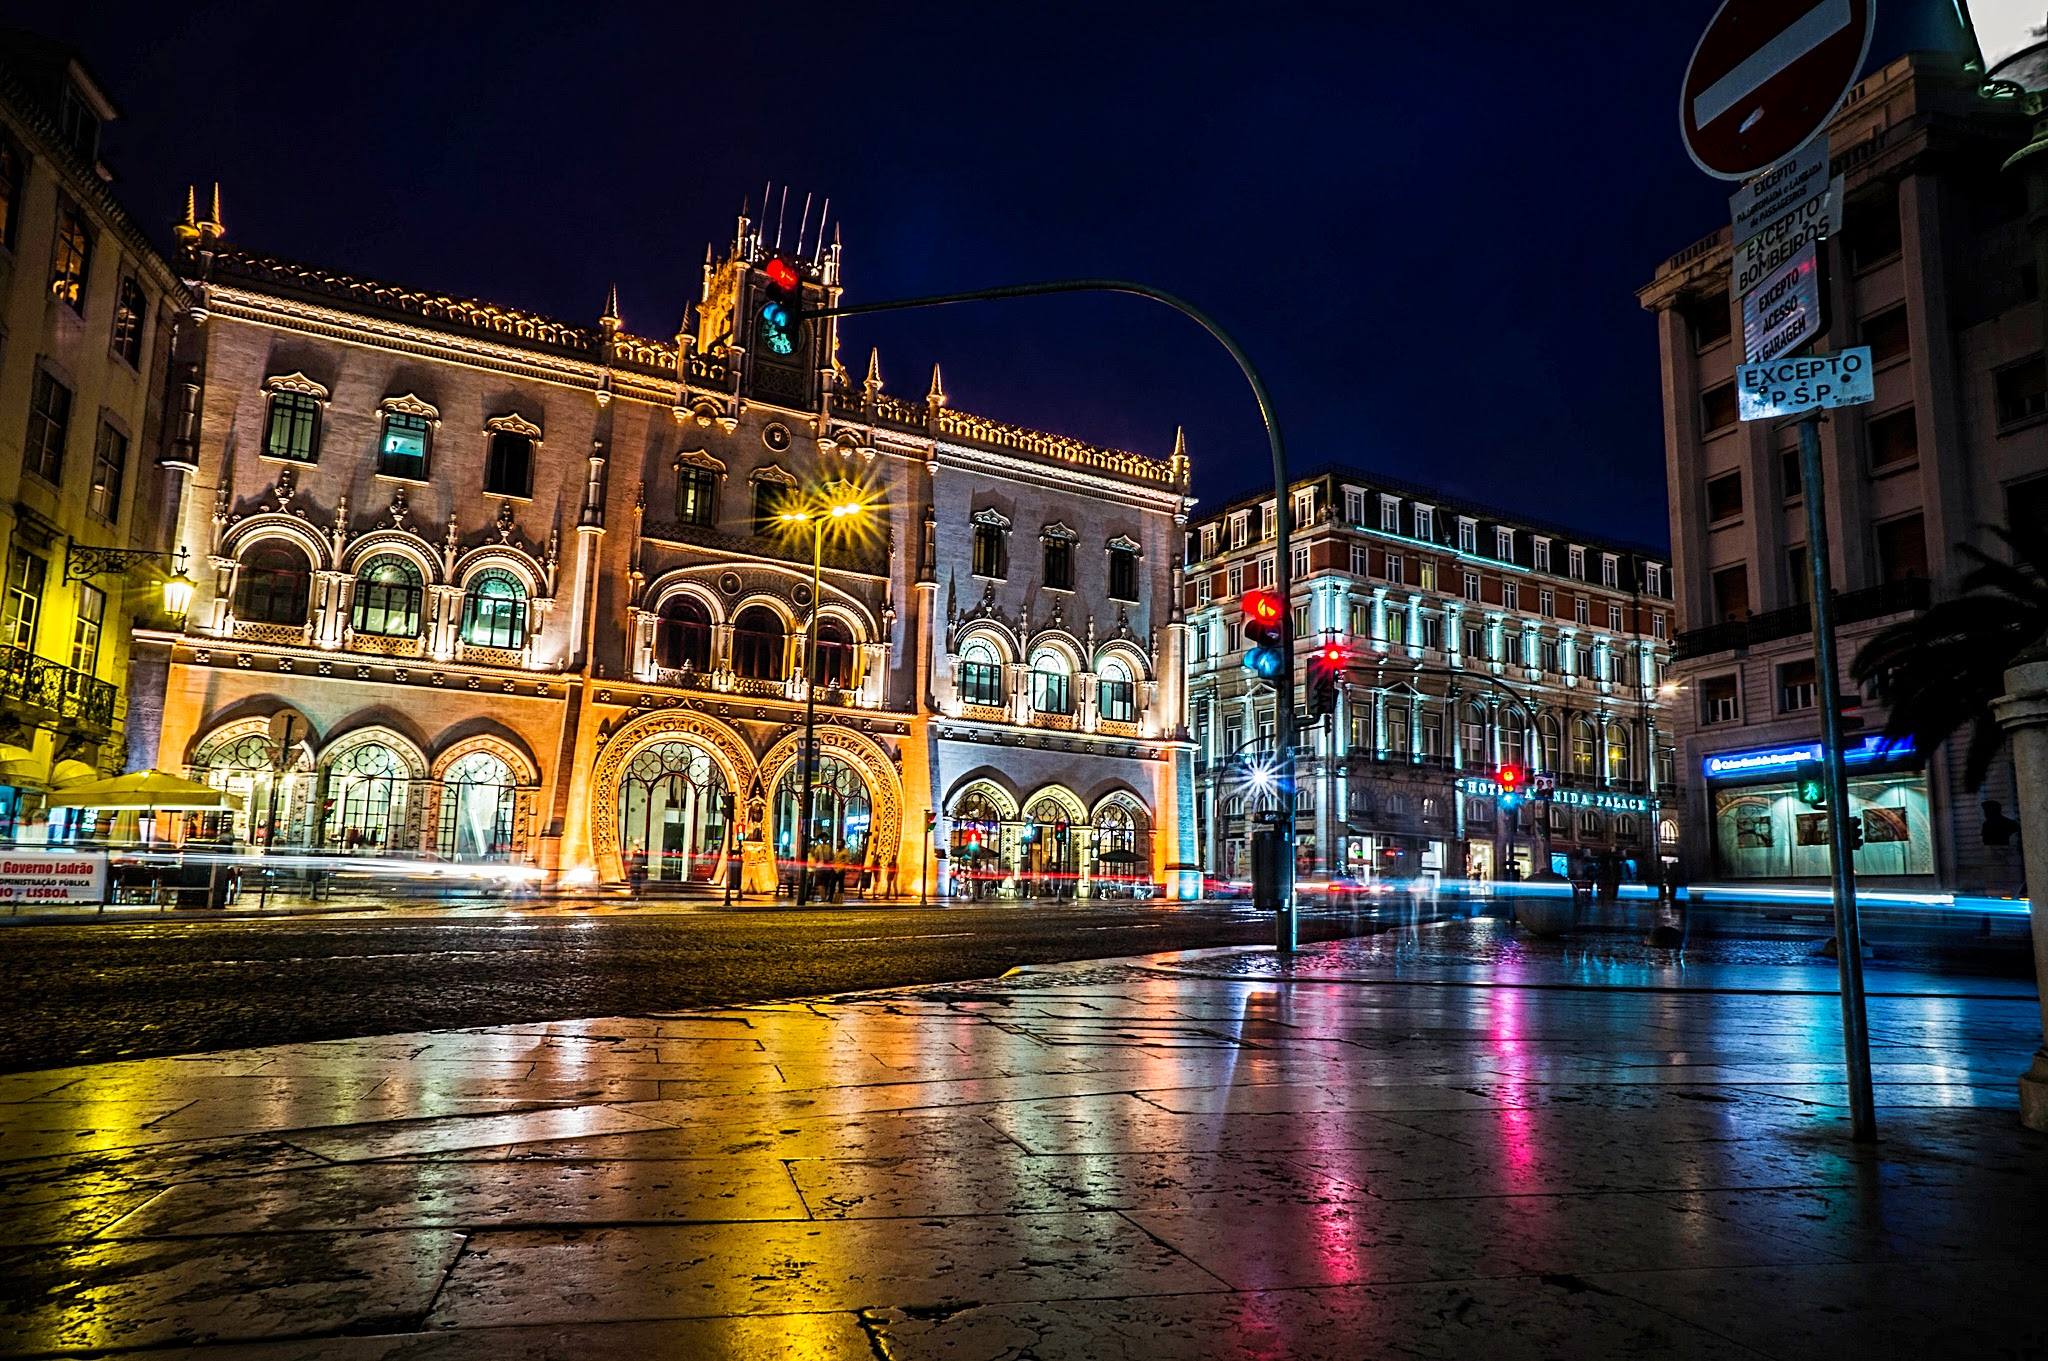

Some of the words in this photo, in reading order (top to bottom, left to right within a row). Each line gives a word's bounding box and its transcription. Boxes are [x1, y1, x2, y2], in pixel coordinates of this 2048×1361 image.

[1753, 159, 1797, 198] EXCEPTO
[1746, 196, 1820, 262] EXCEPTO
[1739, 214, 1830, 291] BOMBEIROS
[1758, 267, 1800, 313] EXCEPTO
[1763, 294, 1799, 335] ACESSO
[1762, 314, 1806, 361] GARAGEM
[1745, 354, 1862, 388] EXCEPTO
[1772, 384, 1838, 408] P.S.P.
[1524, 787, 1590, 806] ANIDA
[1596, 794, 1647, 811] PALACE
[3, 861, 52, 875] Governo
[55, 862, 94, 875] Ladrão
[58, 878, 90, 887] PÚBLICA
[26, 888, 69, 898] LISBOA
